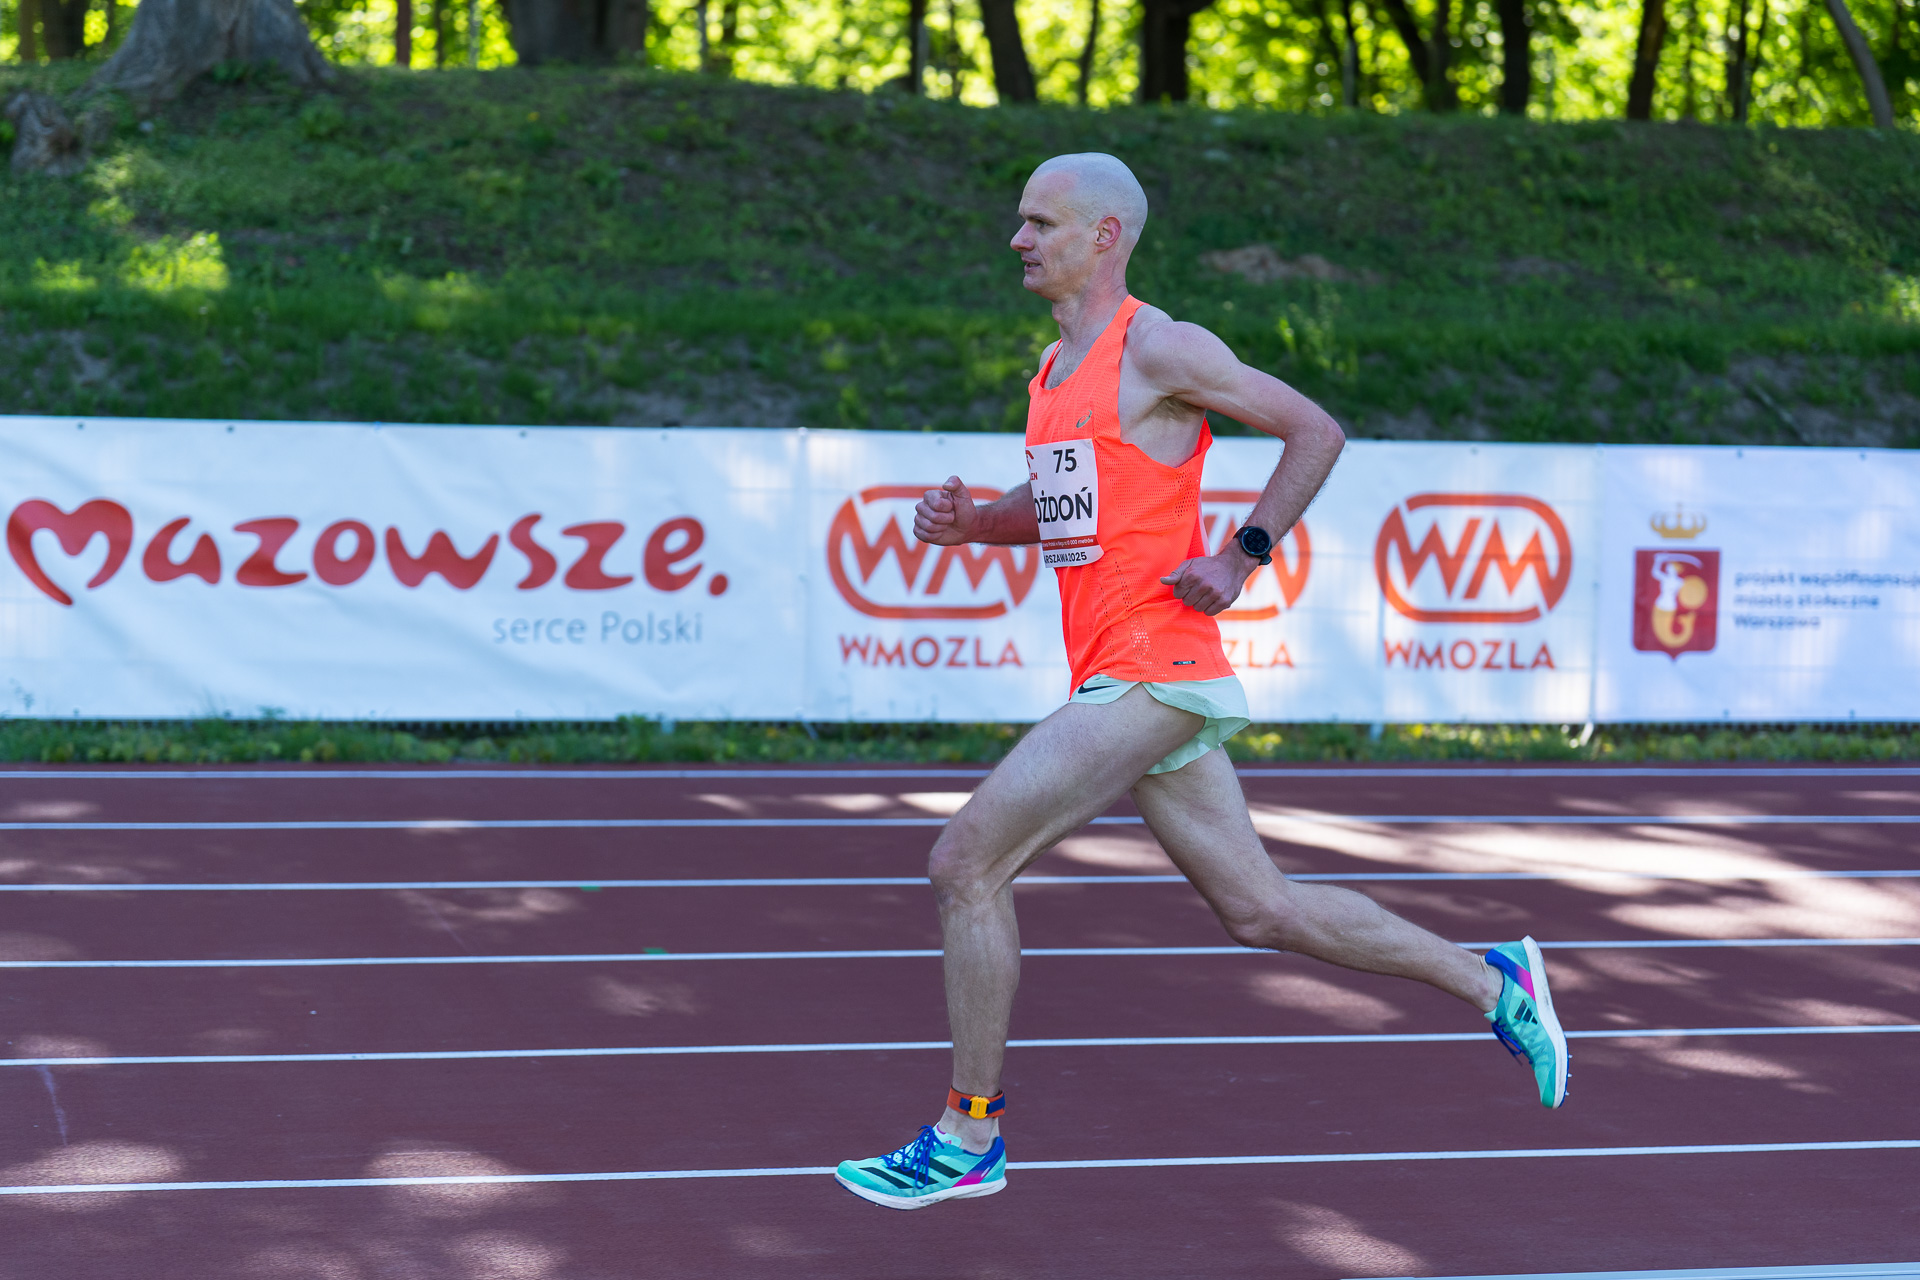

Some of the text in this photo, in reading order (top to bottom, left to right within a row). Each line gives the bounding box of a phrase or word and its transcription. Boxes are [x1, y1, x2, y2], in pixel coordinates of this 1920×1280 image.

[1053, 448, 1077, 473] 75
[6, 498, 729, 606] Mazowsze.
[493, 611, 703, 643] serce Polski
[840, 635, 1023, 668] WMOZLA
[1222, 640, 1295, 668] ZLA
[1384, 637, 1556, 670] WMOZLA
